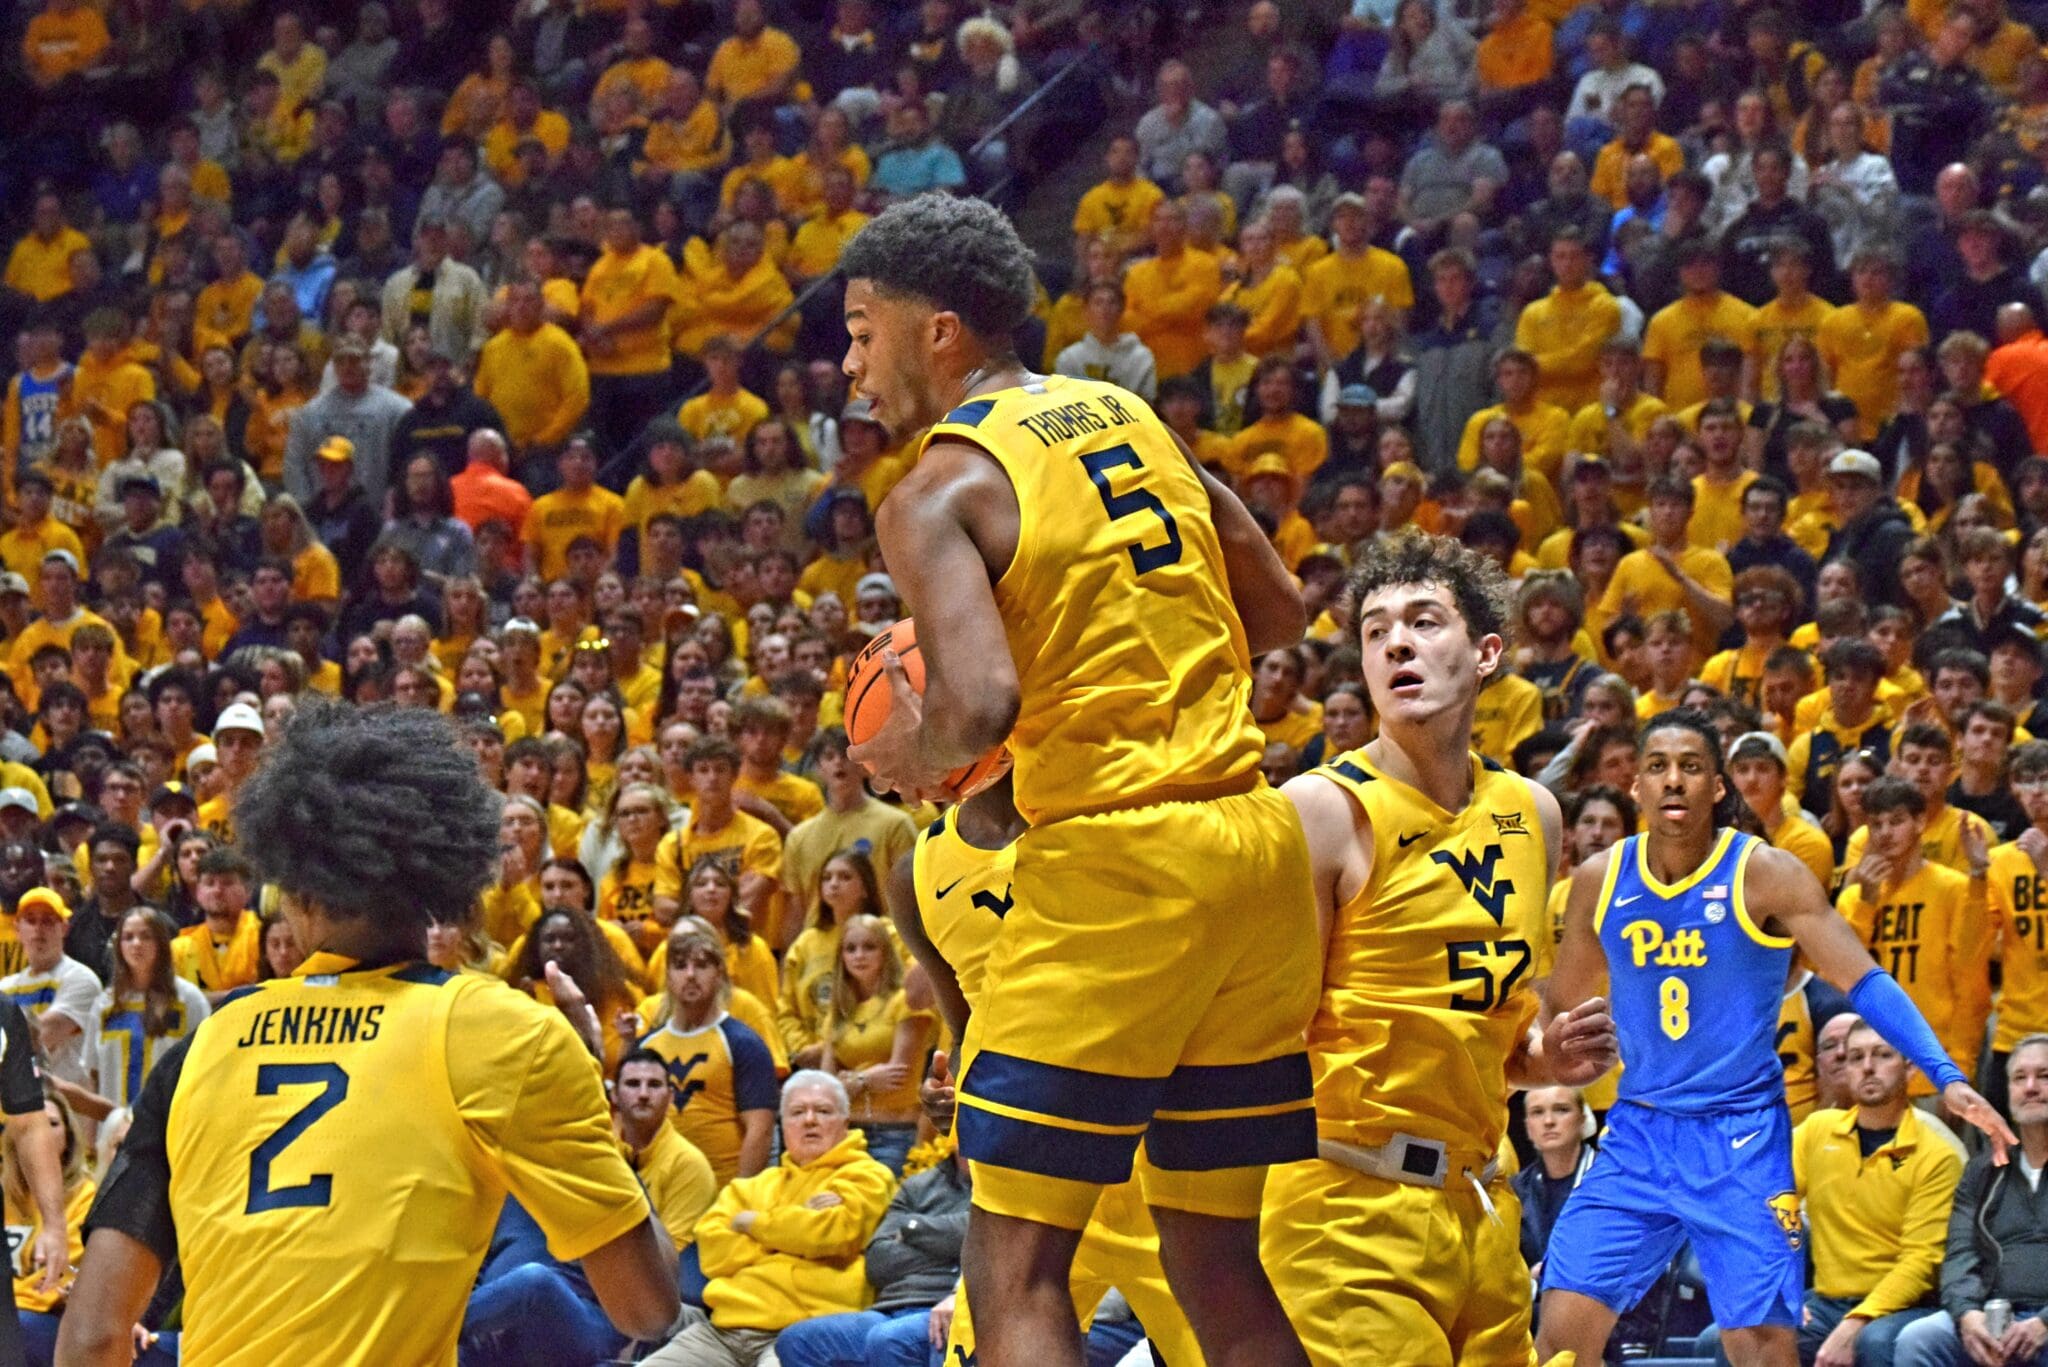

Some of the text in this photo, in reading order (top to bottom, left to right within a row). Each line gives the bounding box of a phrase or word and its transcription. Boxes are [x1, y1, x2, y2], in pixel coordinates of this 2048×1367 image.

[1017, 394, 1140, 447] THOMAS JR.
[1078, 442, 1183, 576] 5
[1620, 919, 1708, 968] Pitt
[237, 1004, 384, 1048] JENKINS
[1659, 975, 1690, 1041] 8
[244, 1062, 349, 1215] 2
